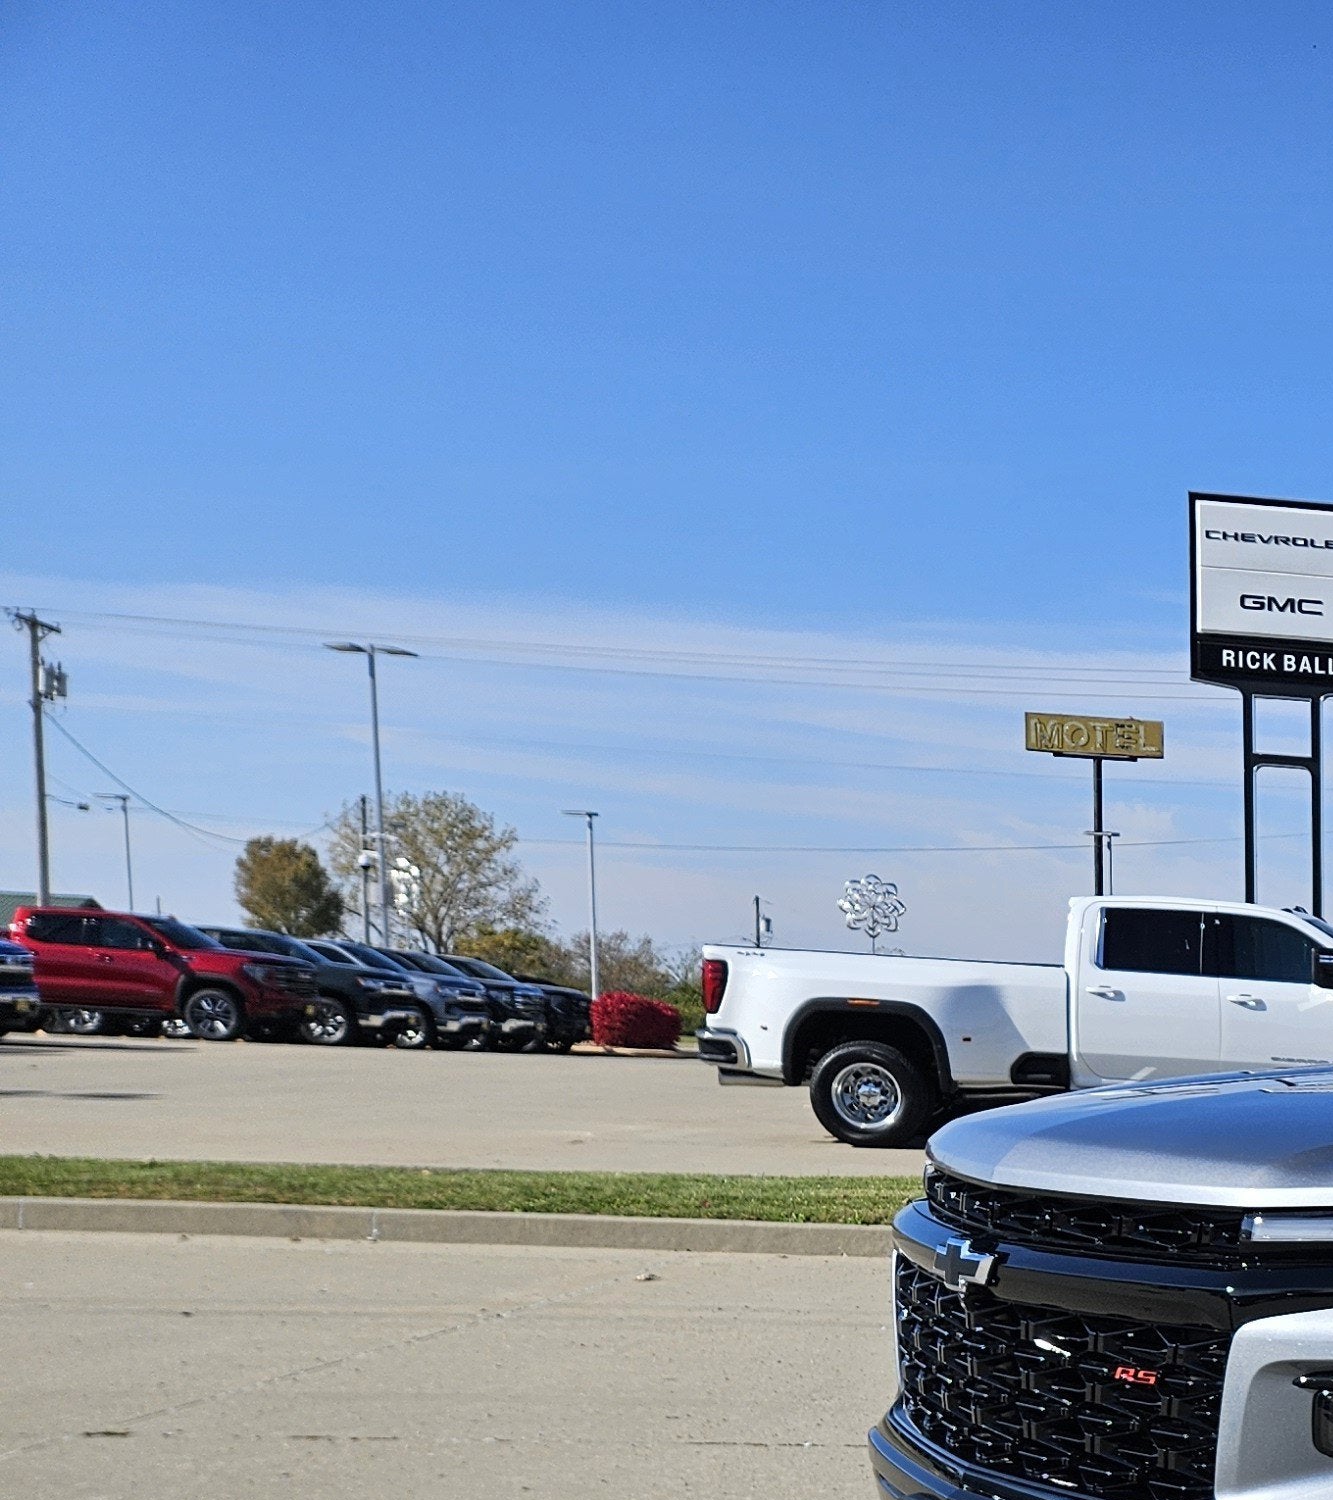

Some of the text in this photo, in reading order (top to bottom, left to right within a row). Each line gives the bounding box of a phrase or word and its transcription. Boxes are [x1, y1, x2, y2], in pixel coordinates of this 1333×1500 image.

[1239, 594, 1324, 616] GMC
[1221, 649, 1277, 671] RICK
[1030, 717, 1160, 752] MOTEL
[1115, 1366, 1157, 1385] RS
